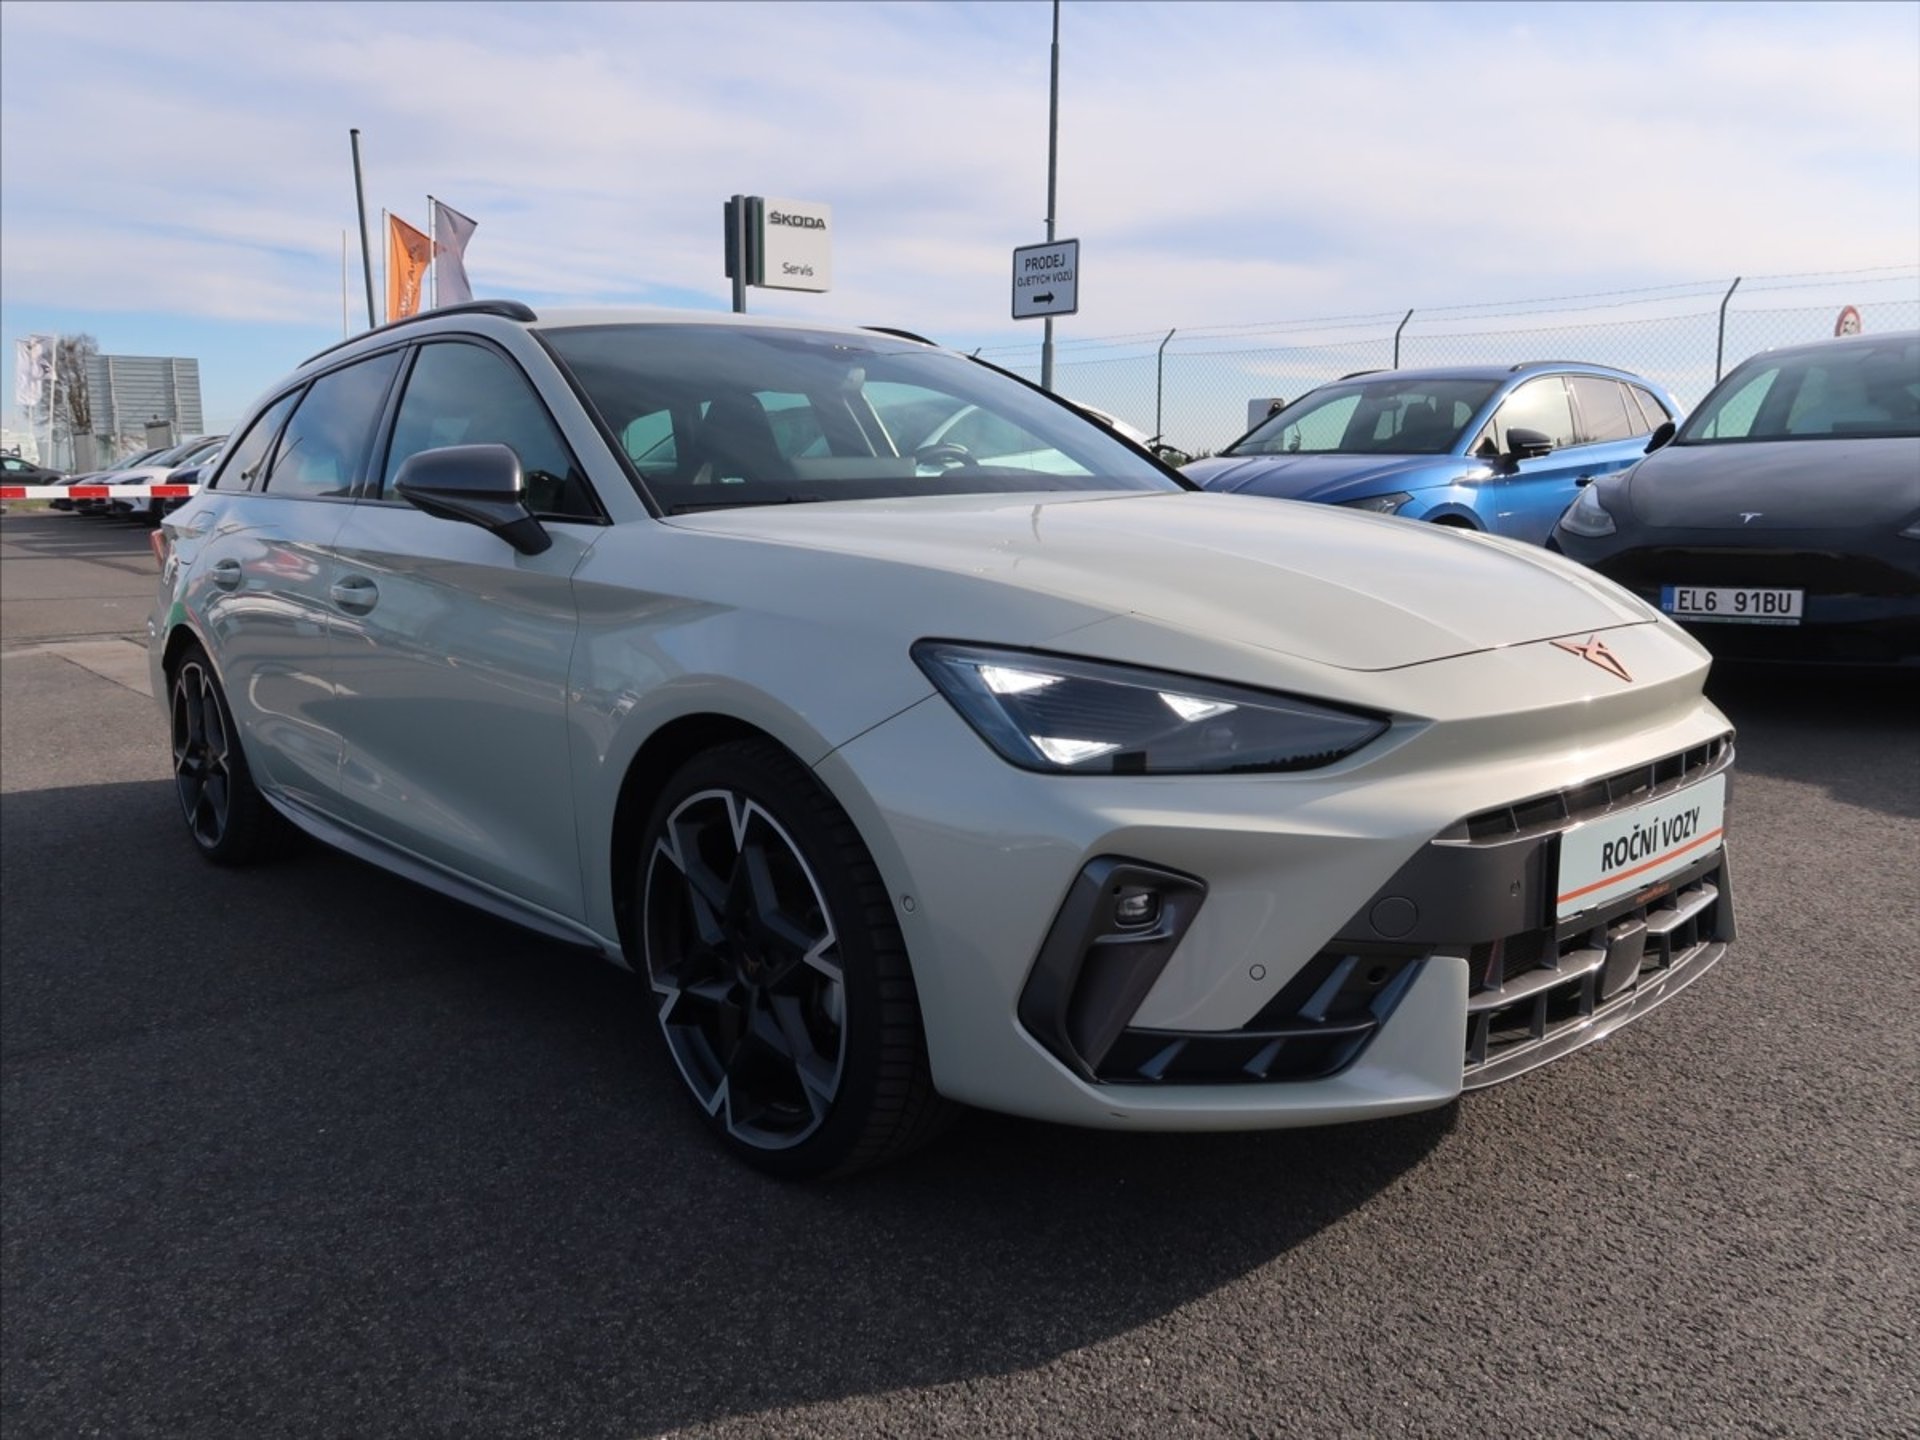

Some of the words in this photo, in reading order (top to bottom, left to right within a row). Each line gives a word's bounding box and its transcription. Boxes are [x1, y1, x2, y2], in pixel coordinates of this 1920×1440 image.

[769, 210, 826, 230] ŠKODA
[782, 262, 814, 277] Servis
[1025, 253, 1066, 271] PRODEJ
[1678, 590, 1717, 612] EL6
[1734, 591, 1792, 614] 91BU
[1601, 816, 1658, 873] ROČNÍ
[1662, 806, 1701, 848] VOZY
